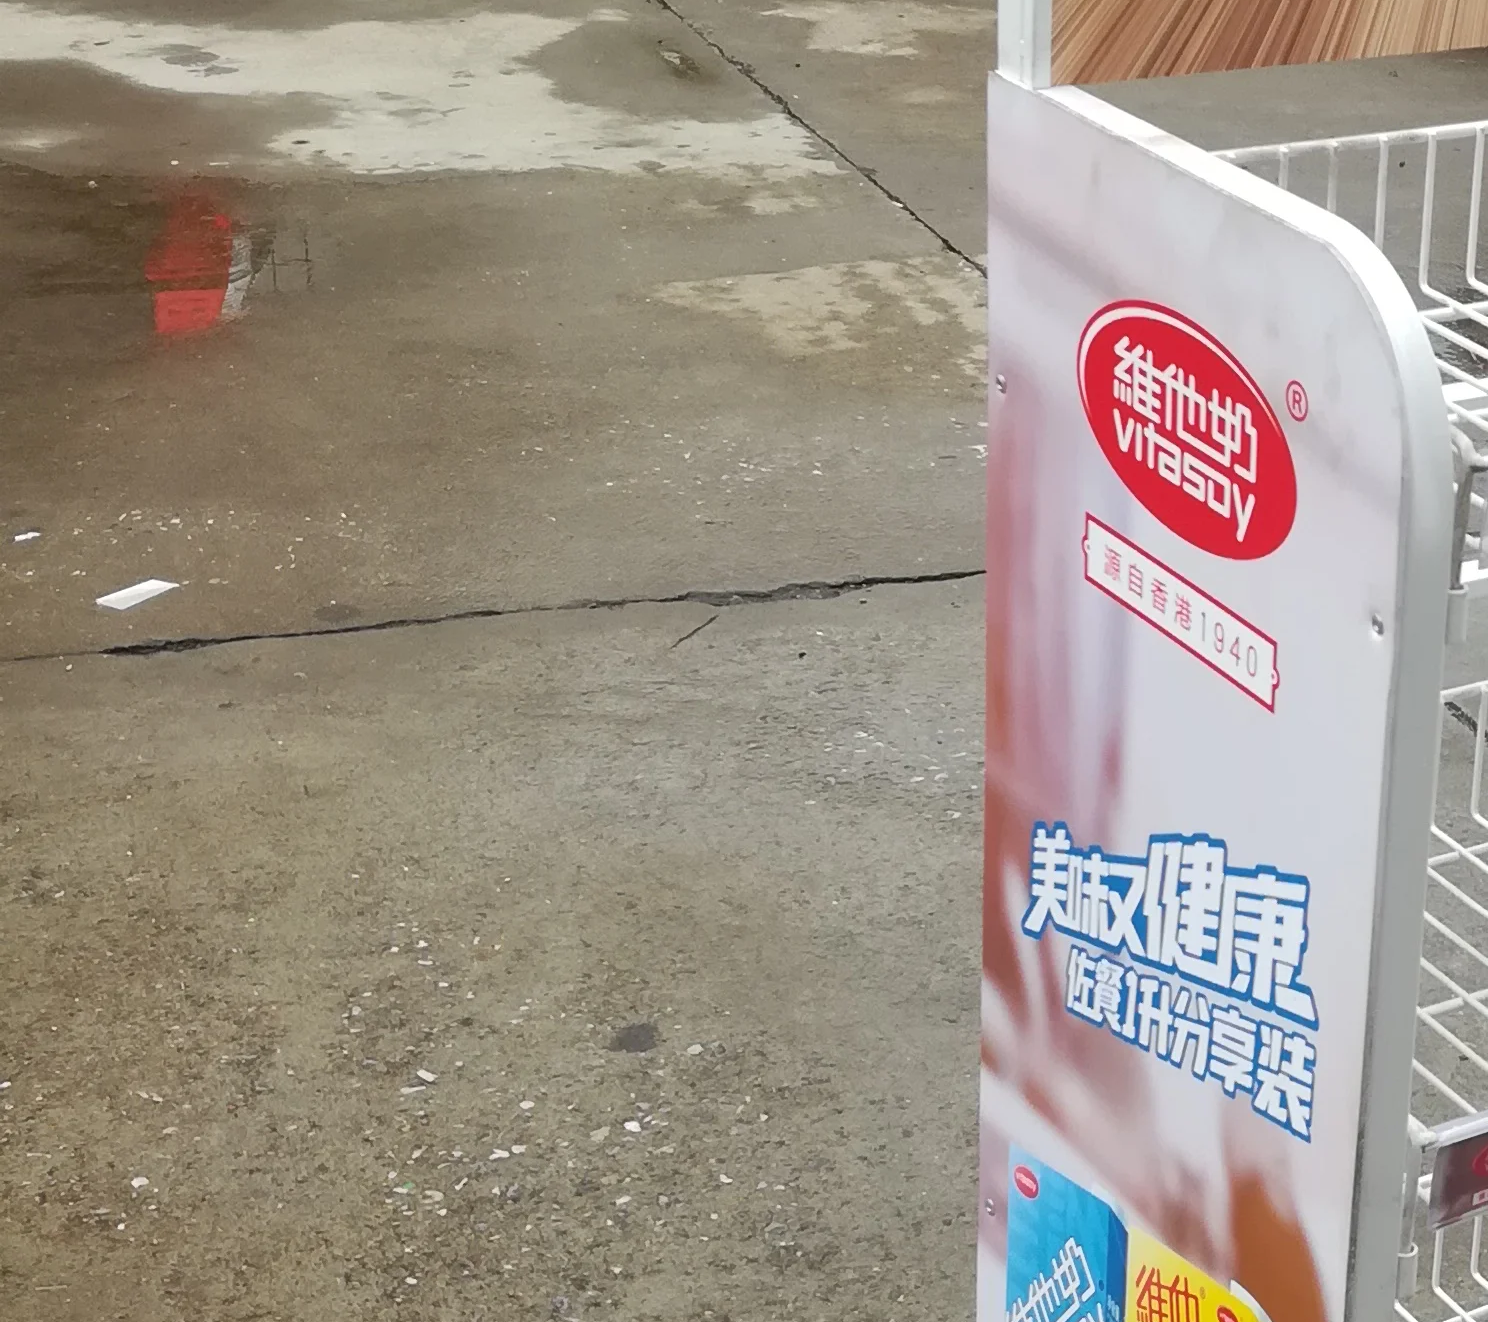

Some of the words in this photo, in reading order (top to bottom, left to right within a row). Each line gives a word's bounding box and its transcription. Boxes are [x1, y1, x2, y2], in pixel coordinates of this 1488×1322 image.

[1022, 822, 1319, 1029] 美味又健康
[1066, 945, 1316, 1142] 佐餐1升分享装
